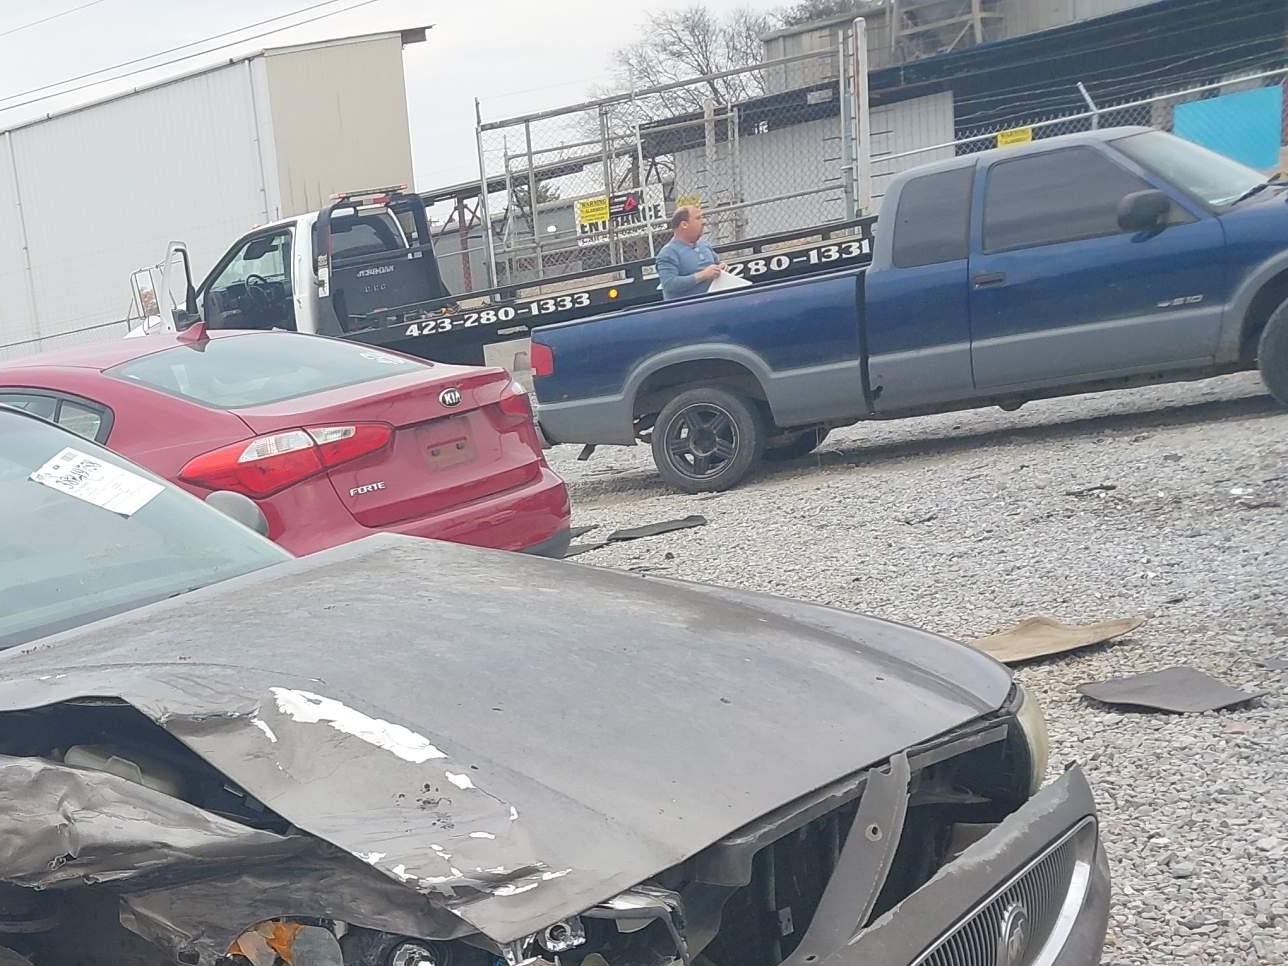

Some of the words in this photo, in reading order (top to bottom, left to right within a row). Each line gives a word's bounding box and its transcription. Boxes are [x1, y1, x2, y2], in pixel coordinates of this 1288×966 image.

[404, 292, 592, 338] 423-280-1333
[443, 391, 460, 405] KIA
[349, 481, 386, 497] FORTE
